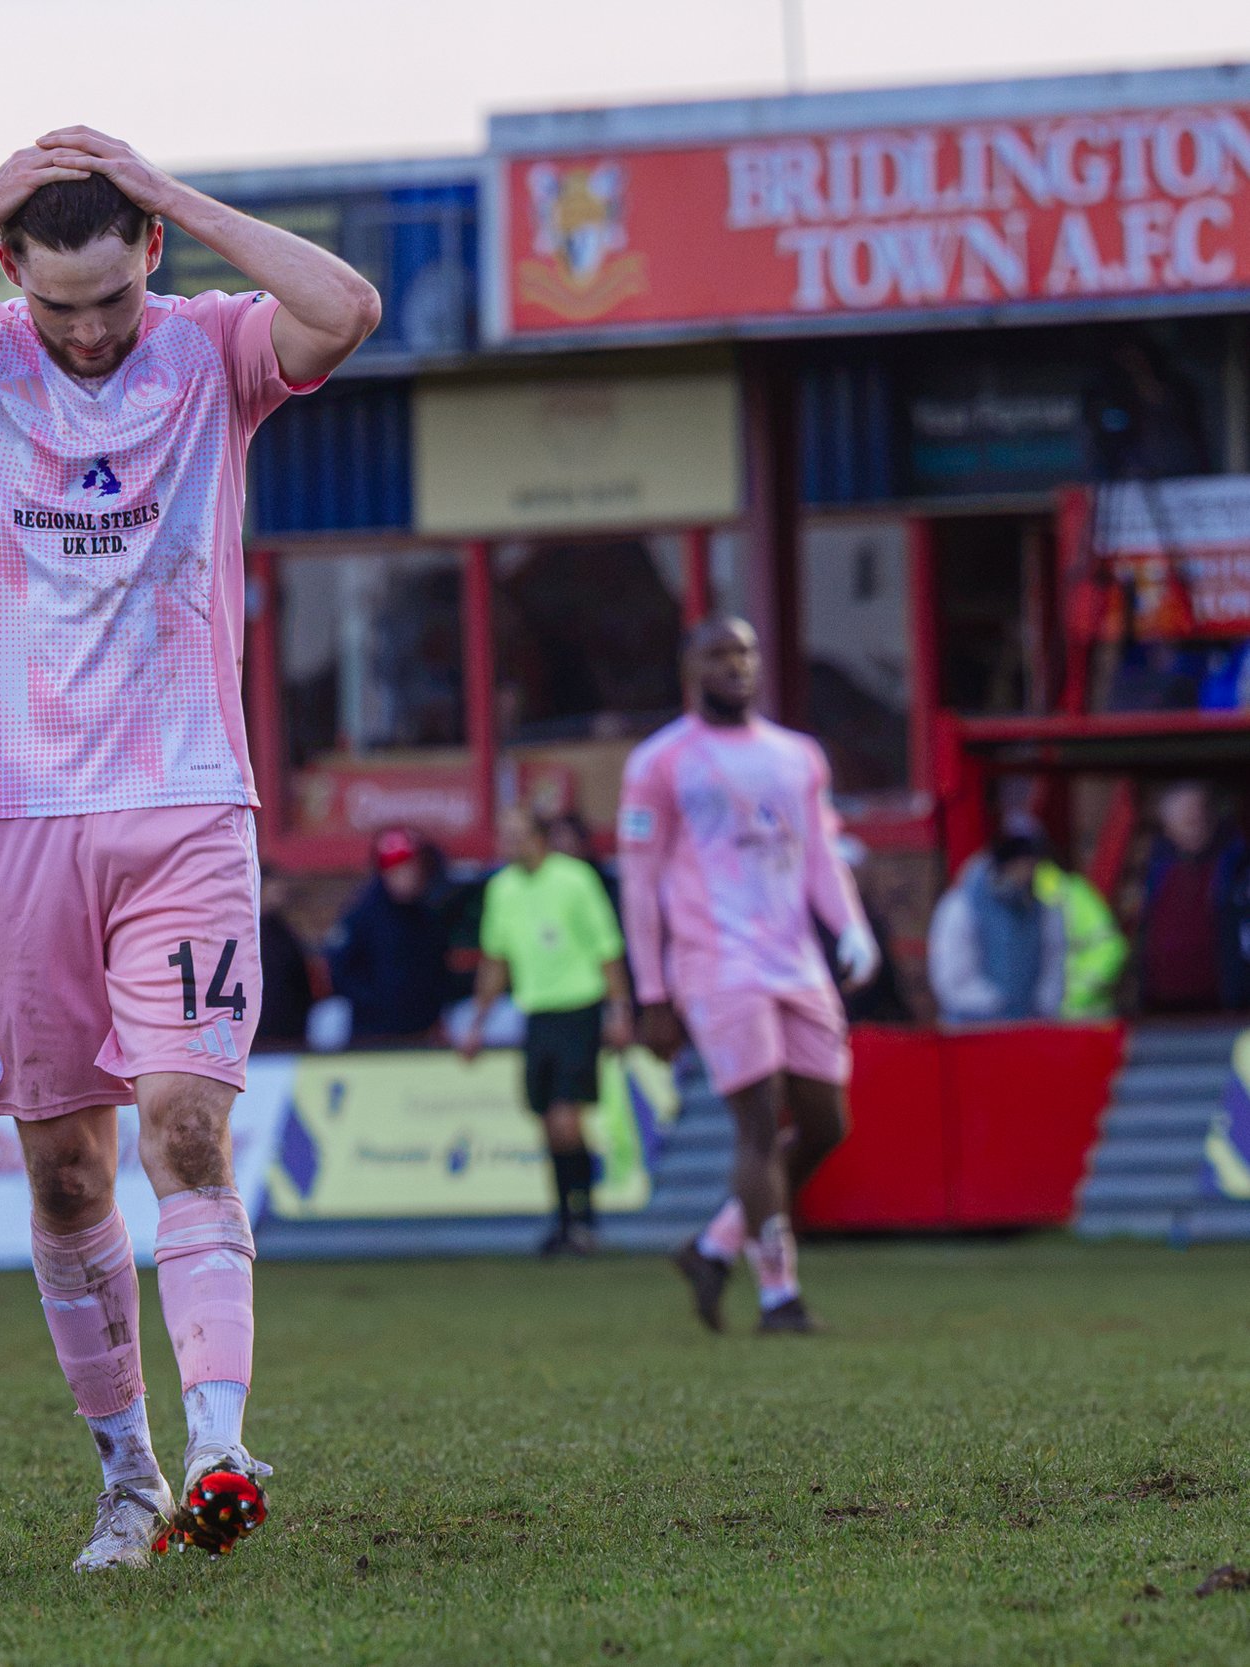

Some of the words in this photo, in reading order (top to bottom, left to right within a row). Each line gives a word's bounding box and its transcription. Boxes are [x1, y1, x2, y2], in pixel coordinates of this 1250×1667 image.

[725, 110, 1250, 230] BRIDLINGTON
[775, 212, 1028, 311] TOWN
[13, 508, 97, 531] REGIONAL
[100, 502, 160, 530] STEELS
[62, 536, 87, 555] UK
[91, 535, 128, 555] LTD.
[168, 939, 246, 1021] 14
